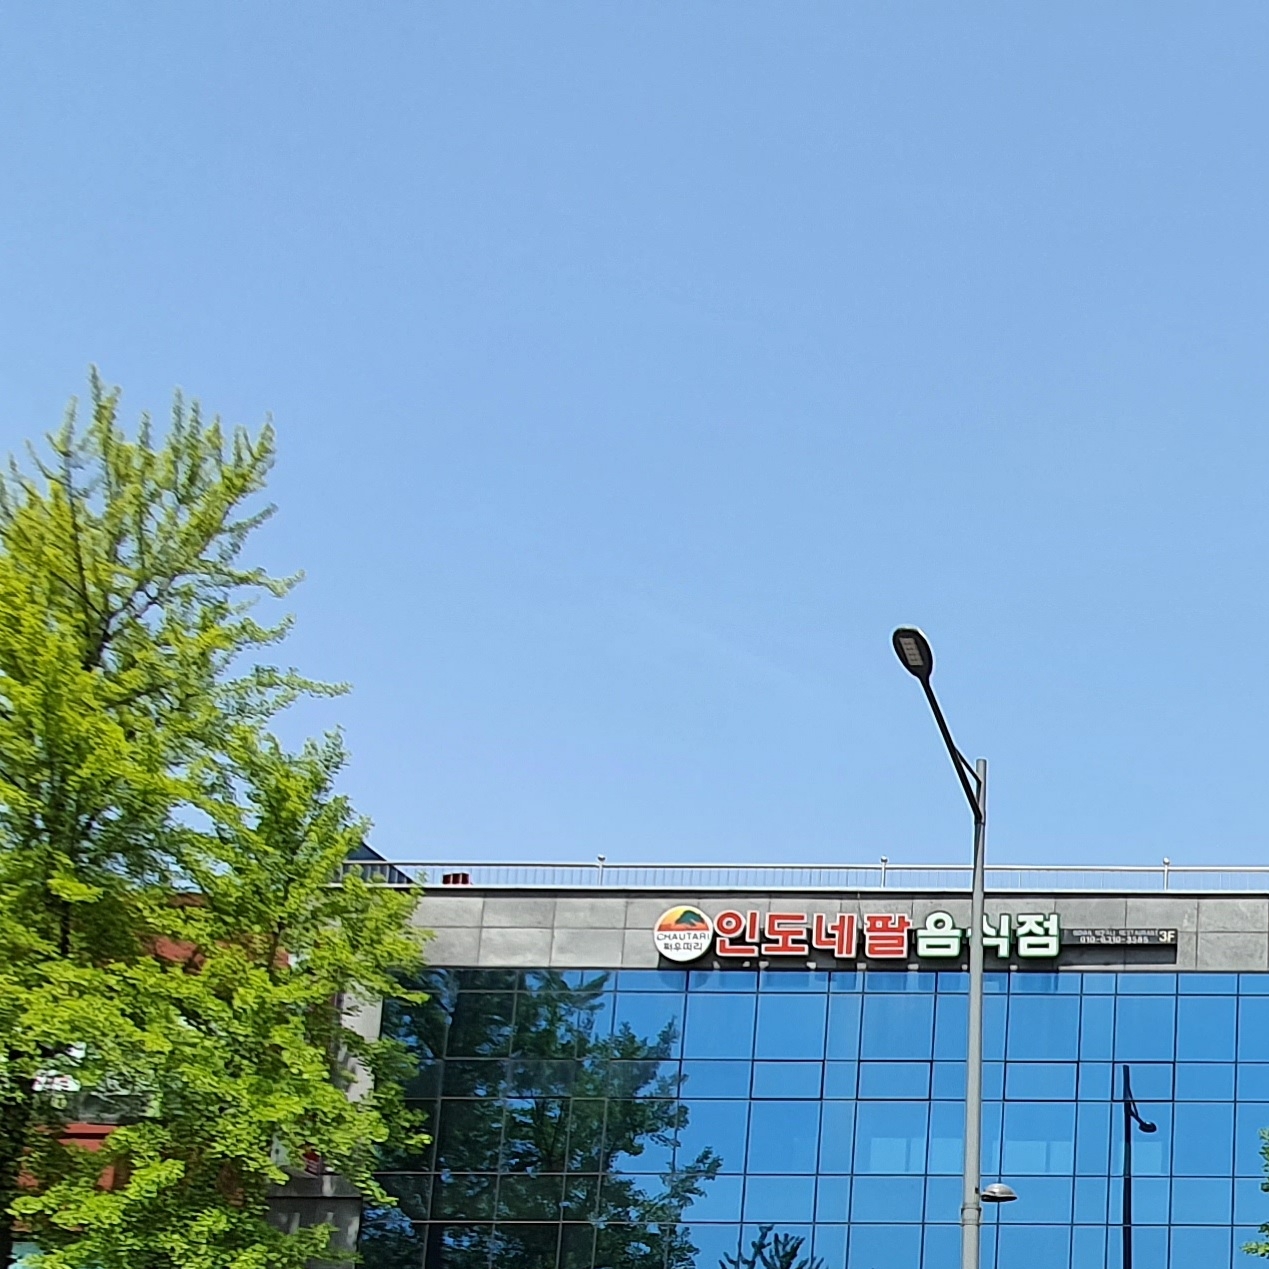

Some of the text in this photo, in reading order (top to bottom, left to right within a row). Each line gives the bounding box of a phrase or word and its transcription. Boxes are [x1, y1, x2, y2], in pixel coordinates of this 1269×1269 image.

[656, 932, 710, 941] CHAUTARI
[714, 910, 1060, 958] 인도네팔 음식점
[1158, 929, 1175, 943] 3F
